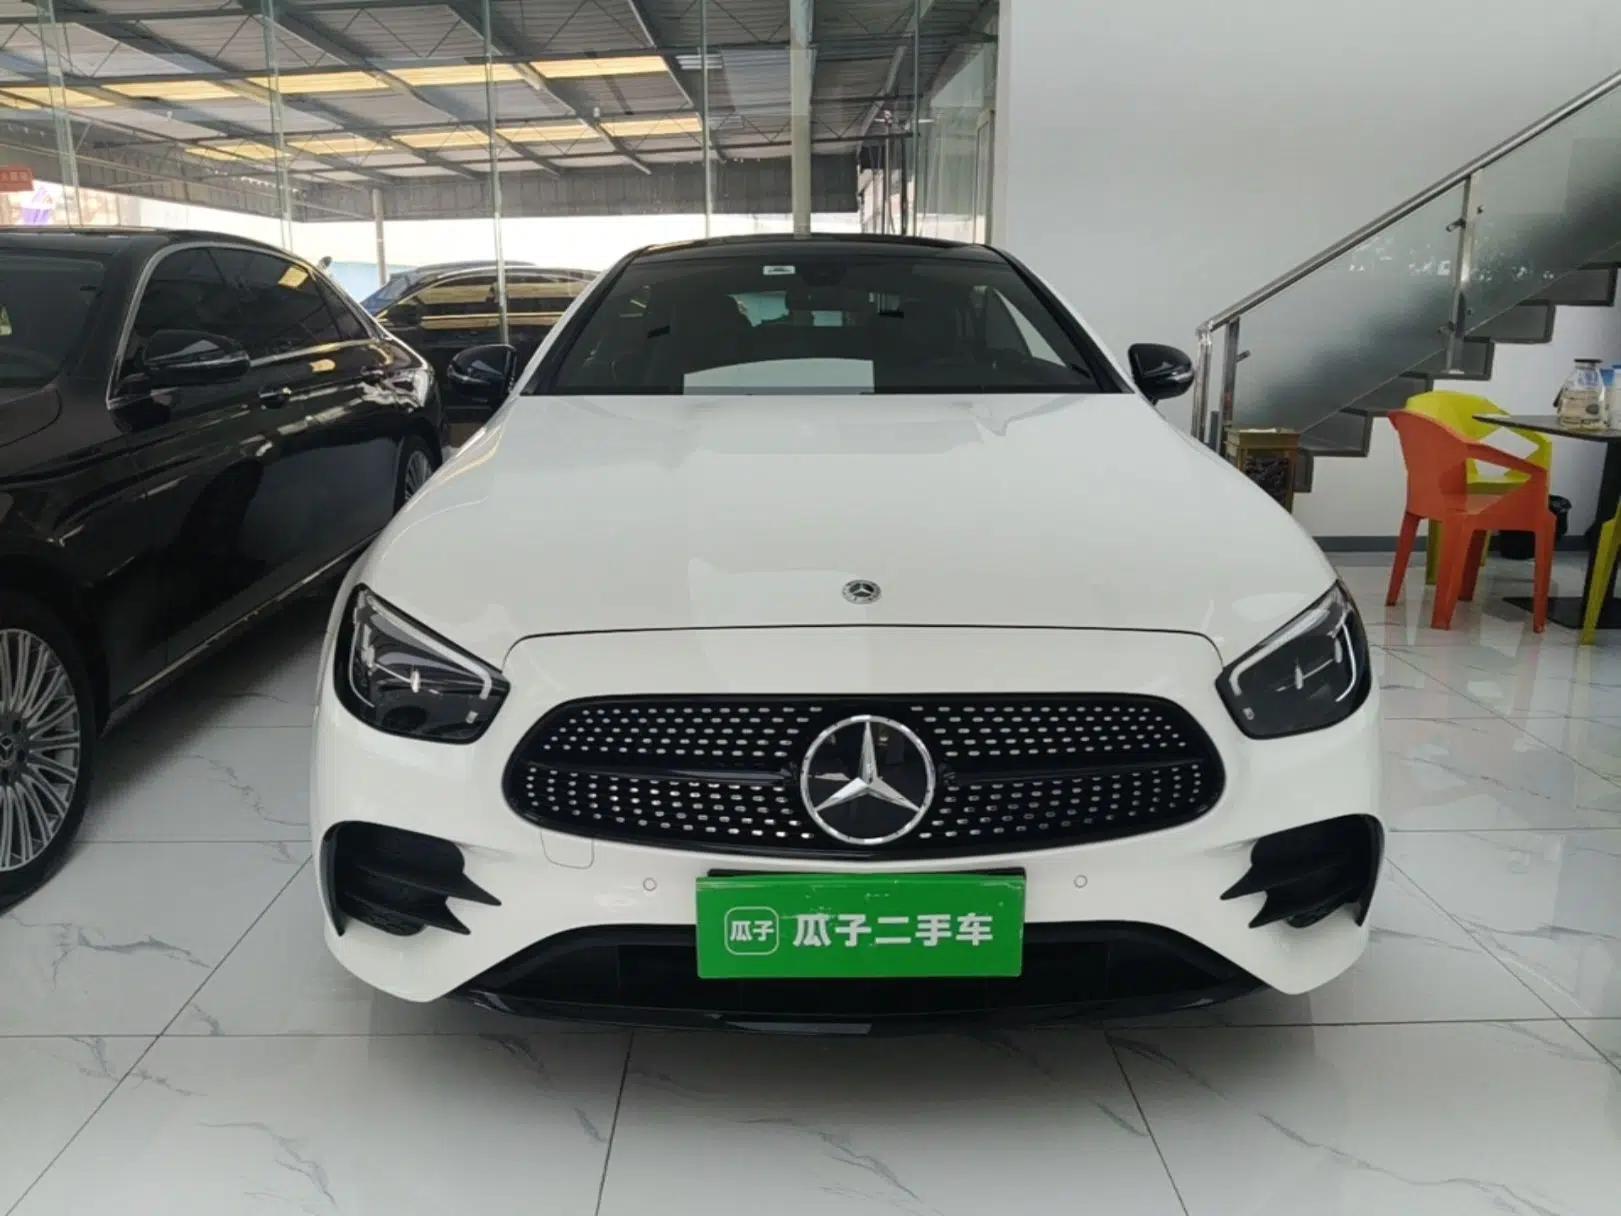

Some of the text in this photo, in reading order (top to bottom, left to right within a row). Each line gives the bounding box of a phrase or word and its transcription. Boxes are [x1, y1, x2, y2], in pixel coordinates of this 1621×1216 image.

[730, 913, 993, 947] 瓜子 瓜子二手车
